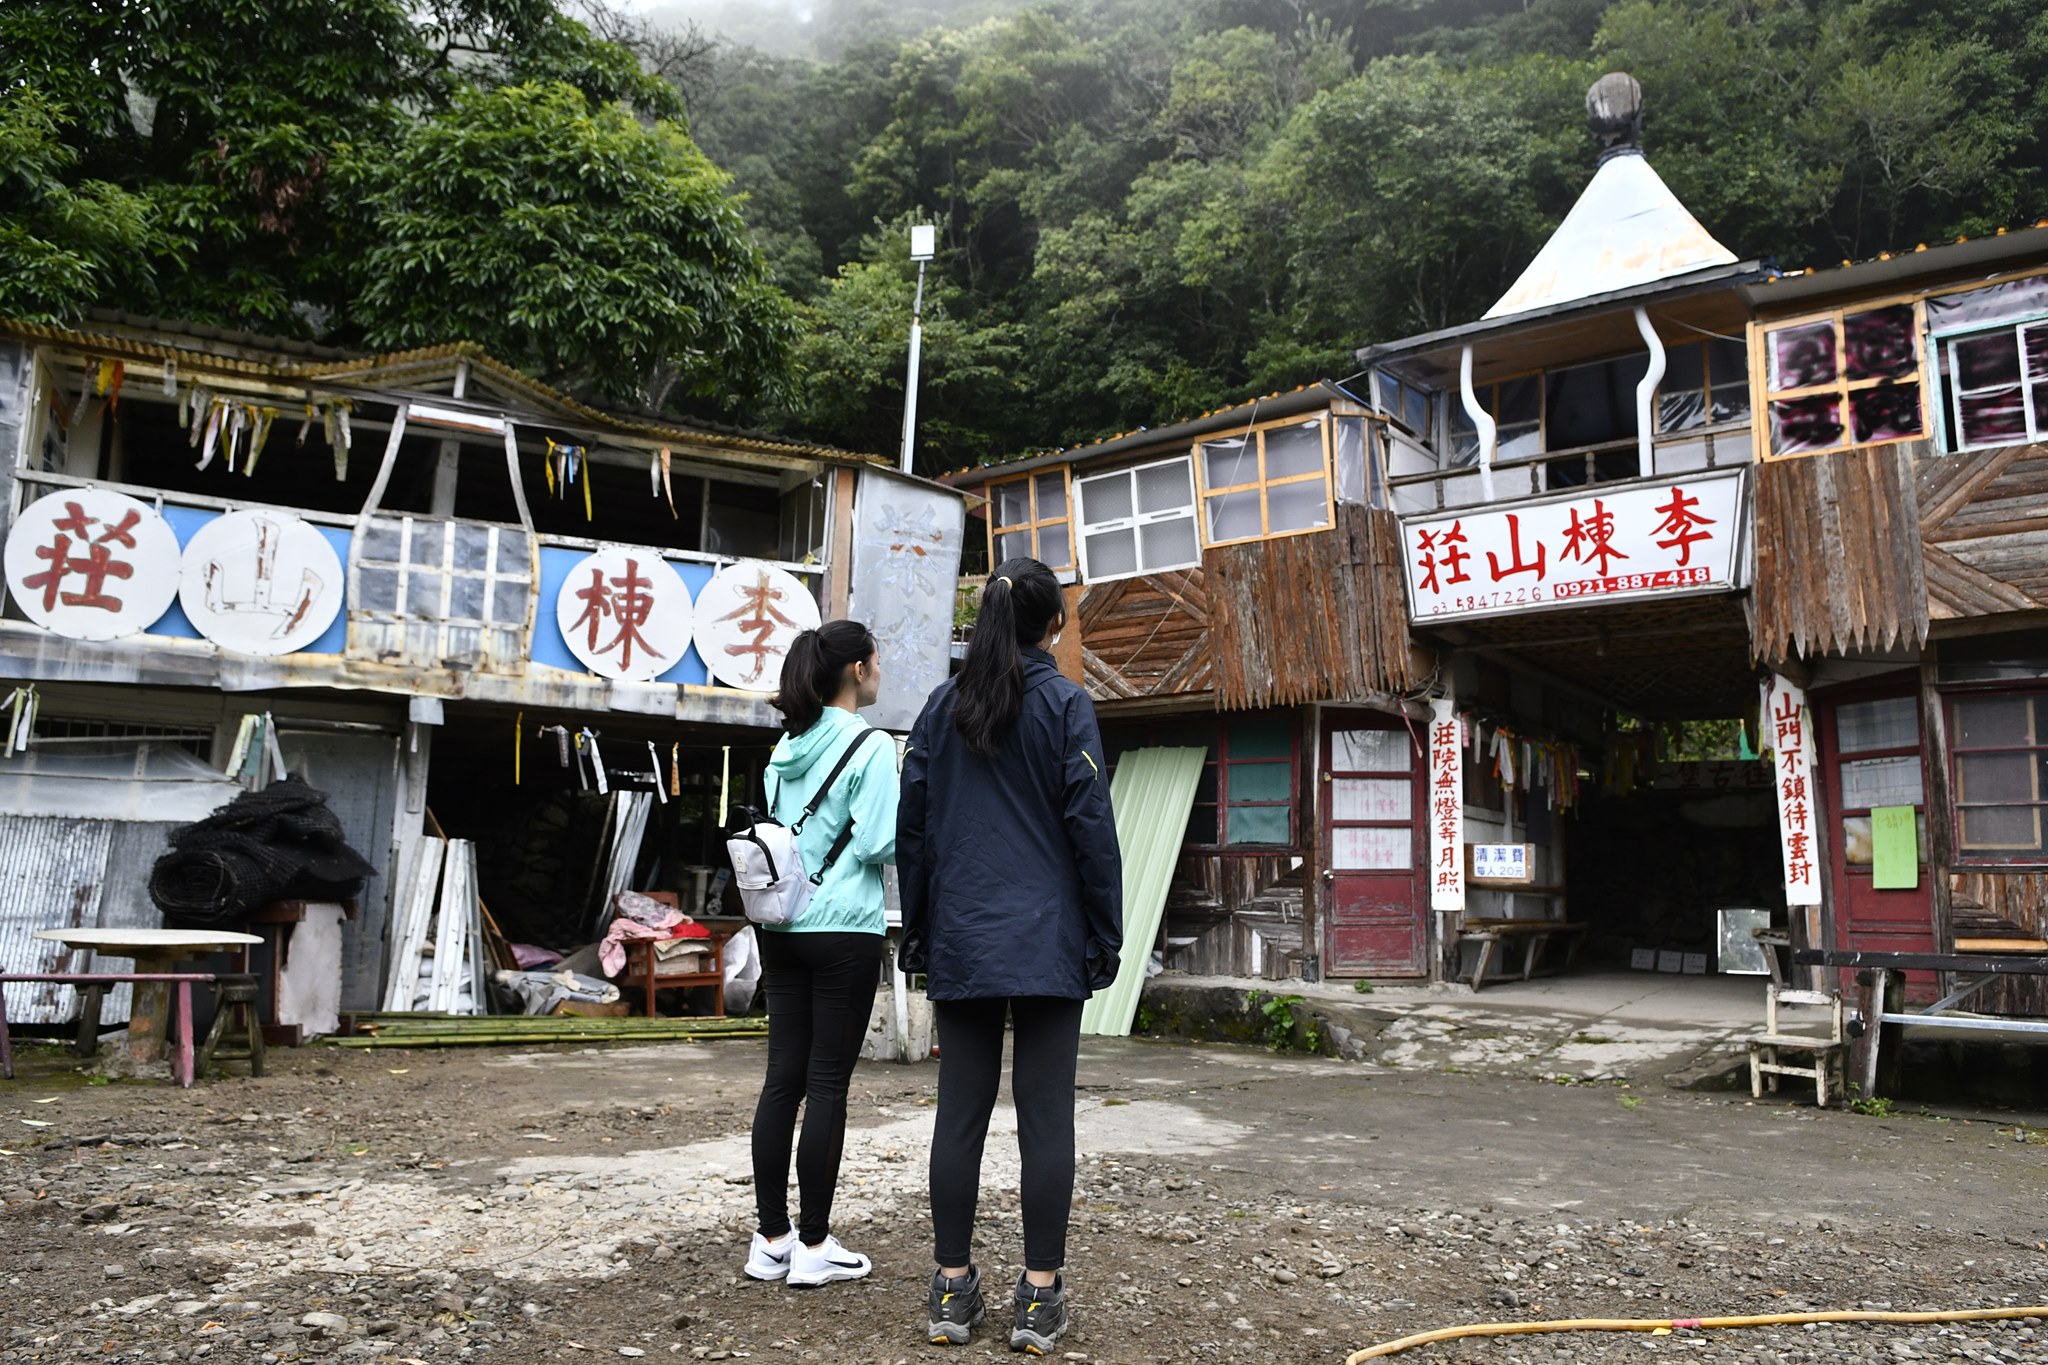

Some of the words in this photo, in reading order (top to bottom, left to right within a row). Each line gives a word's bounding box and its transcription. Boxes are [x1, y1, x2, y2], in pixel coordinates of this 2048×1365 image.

[1556, 568, 1709, 597] 0921-887-418
[1433, 721, 1461, 894] 莊院無燈等月照
[1775, 692, 1813, 886] 山門不鎖待雲封
[1475, 847, 1524, 863] 清潔費
